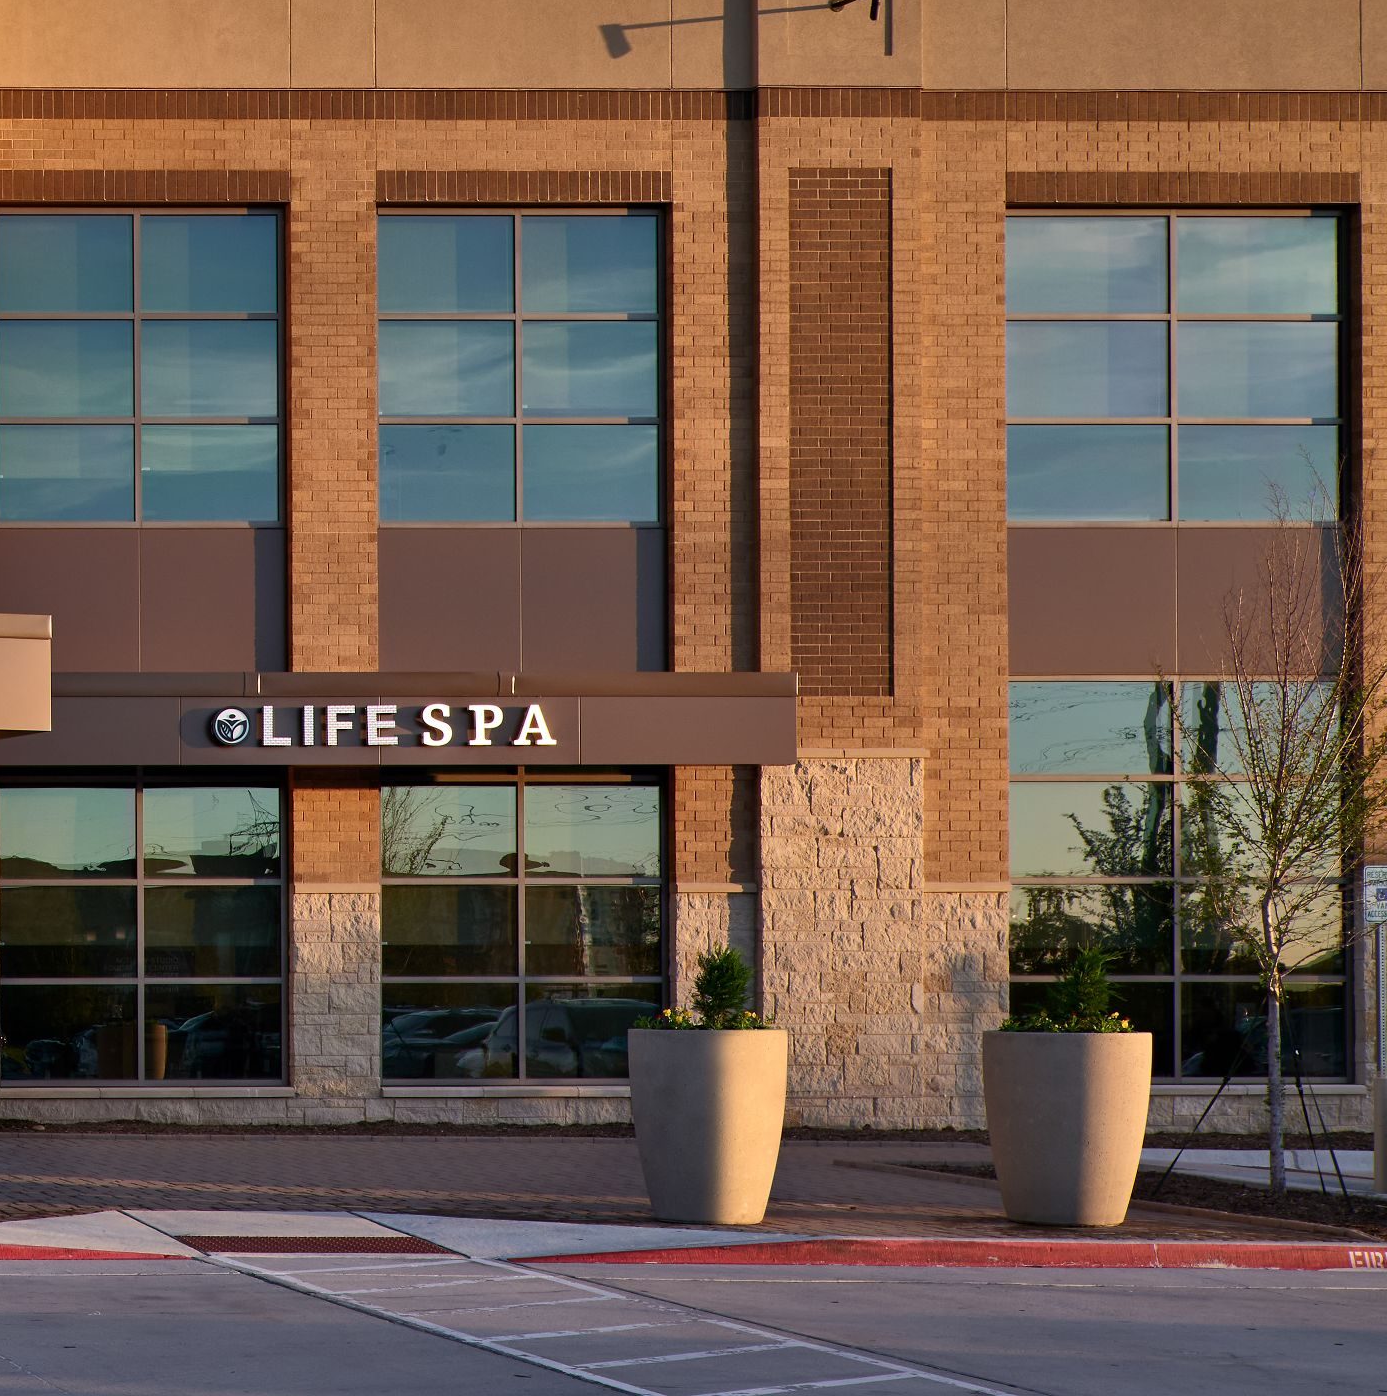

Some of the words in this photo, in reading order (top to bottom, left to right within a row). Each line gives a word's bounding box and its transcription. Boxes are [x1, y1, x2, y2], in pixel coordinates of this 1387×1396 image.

[261, 704, 398, 747] LIFE
[421, 703, 558, 747] SPA
[1349, 1251, 1387, 1268] FIR
